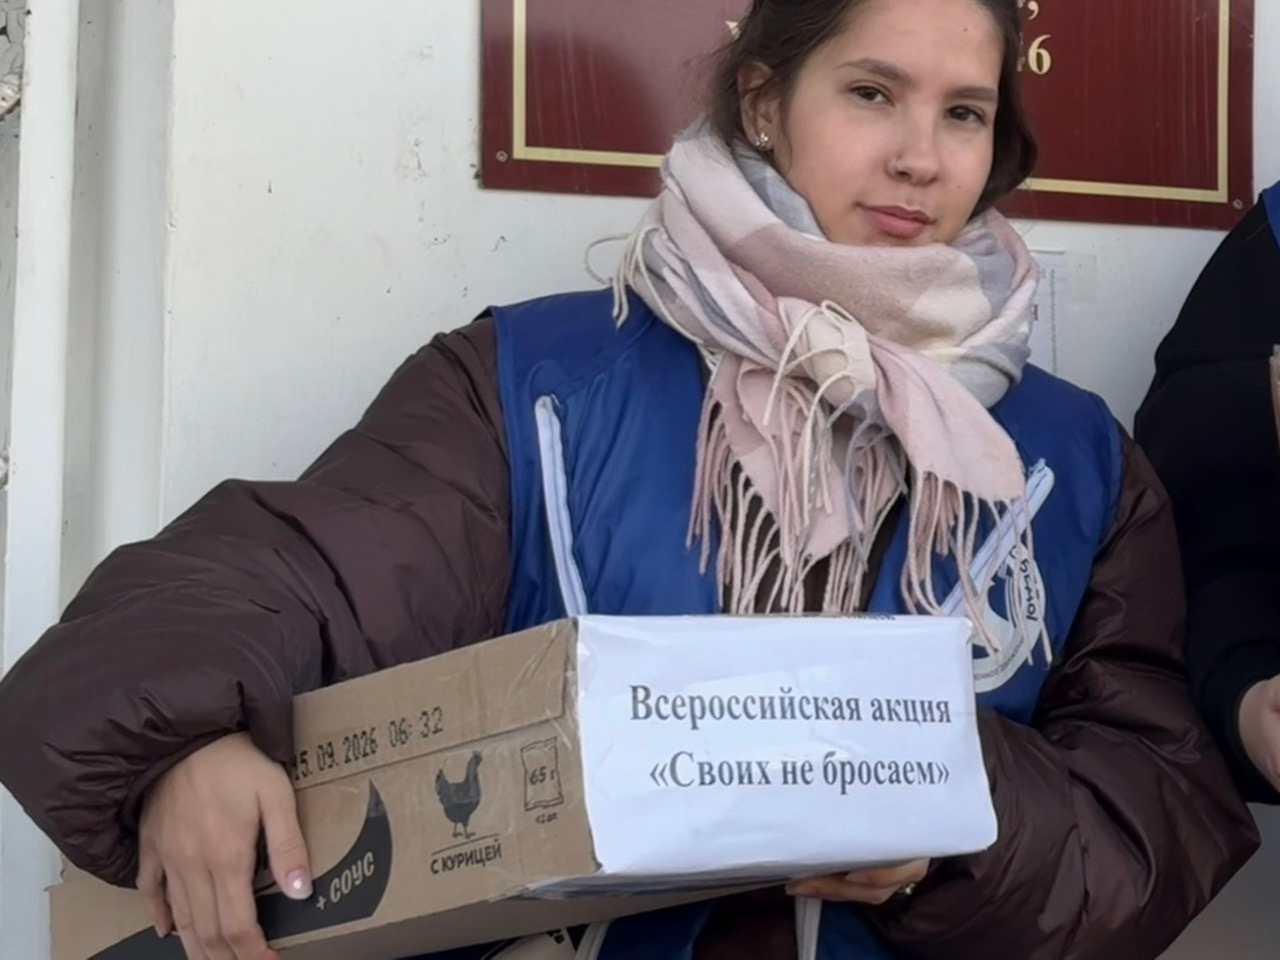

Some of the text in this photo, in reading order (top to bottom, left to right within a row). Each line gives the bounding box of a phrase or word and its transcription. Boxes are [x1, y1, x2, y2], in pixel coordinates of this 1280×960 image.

[629, 684, 952, 731] Всероссийская акция
[649, 750, 950, 796] «Своих не бросаем»
[329, 850, 375, 904] СОУС
[442, 838, 503, 873] КУРИЦЕЙ
